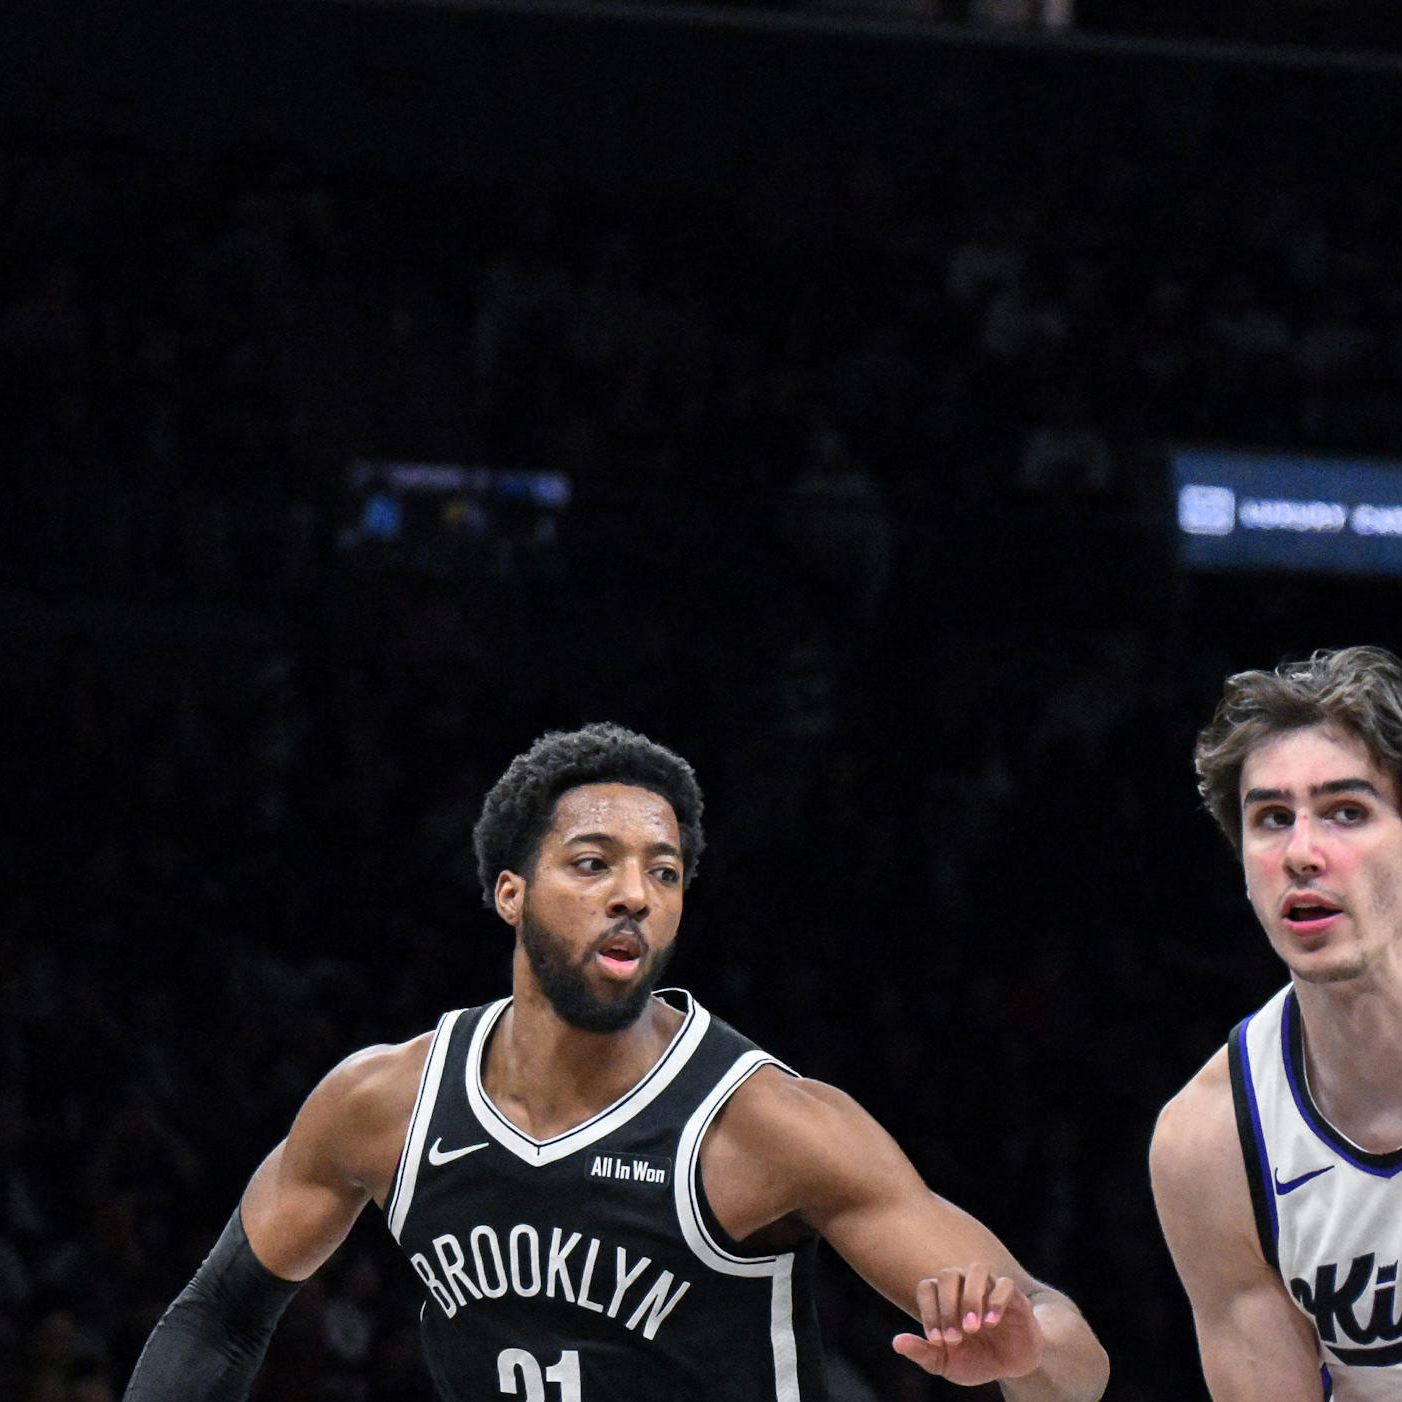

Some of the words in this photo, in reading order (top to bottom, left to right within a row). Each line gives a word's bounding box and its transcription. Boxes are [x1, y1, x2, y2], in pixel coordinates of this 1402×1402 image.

[590, 1156, 613, 1178] All
[615, 1158, 631, 1180] In
[633, 1160, 666, 1184] Won
[411, 1224, 691, 1341] BROOKLYN
